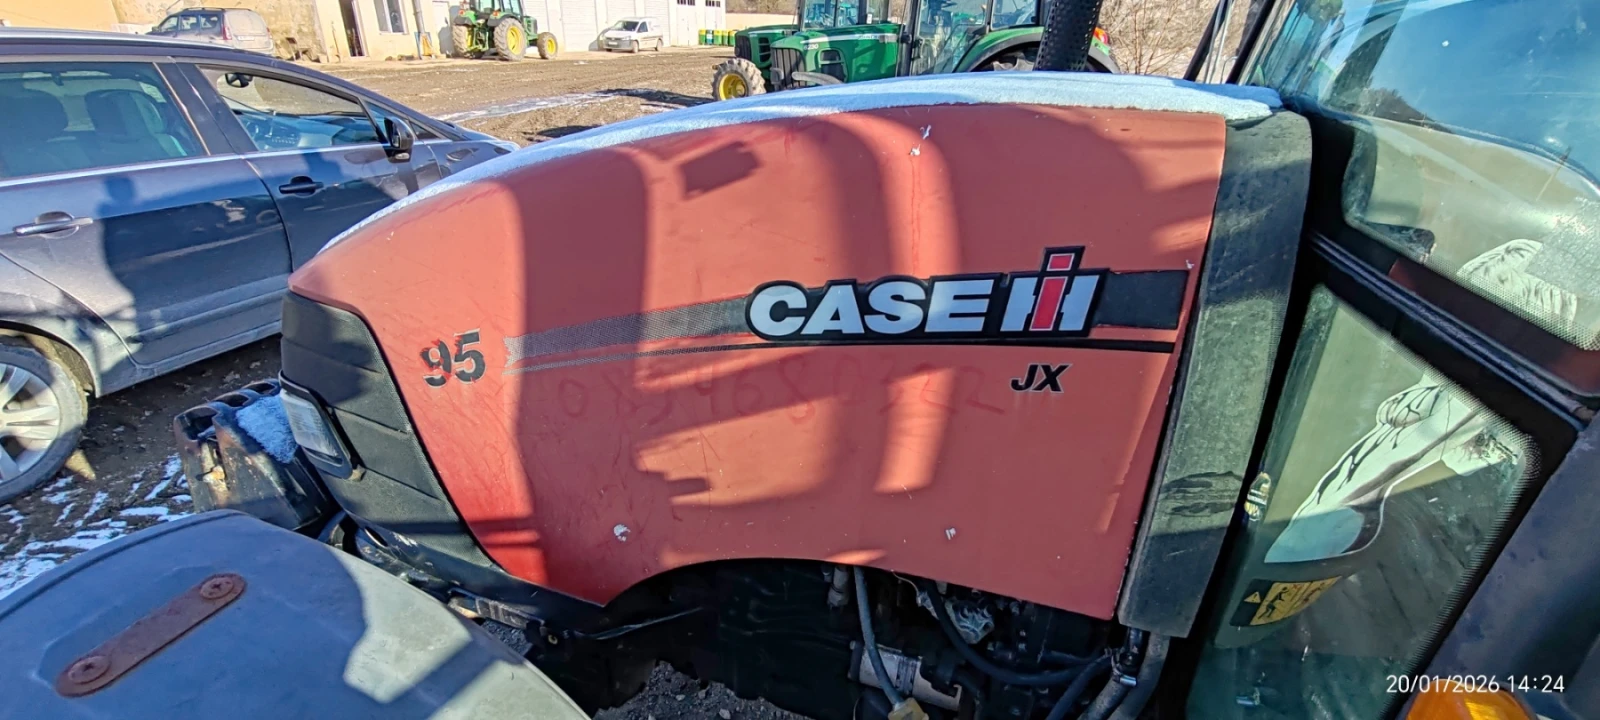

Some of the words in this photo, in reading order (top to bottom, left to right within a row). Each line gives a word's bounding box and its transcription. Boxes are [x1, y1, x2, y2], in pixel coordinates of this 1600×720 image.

[749, 279, 996, 337] CASE
[419, 328, 486, 388] 95
[1009, 363, 1073, 393] JX
